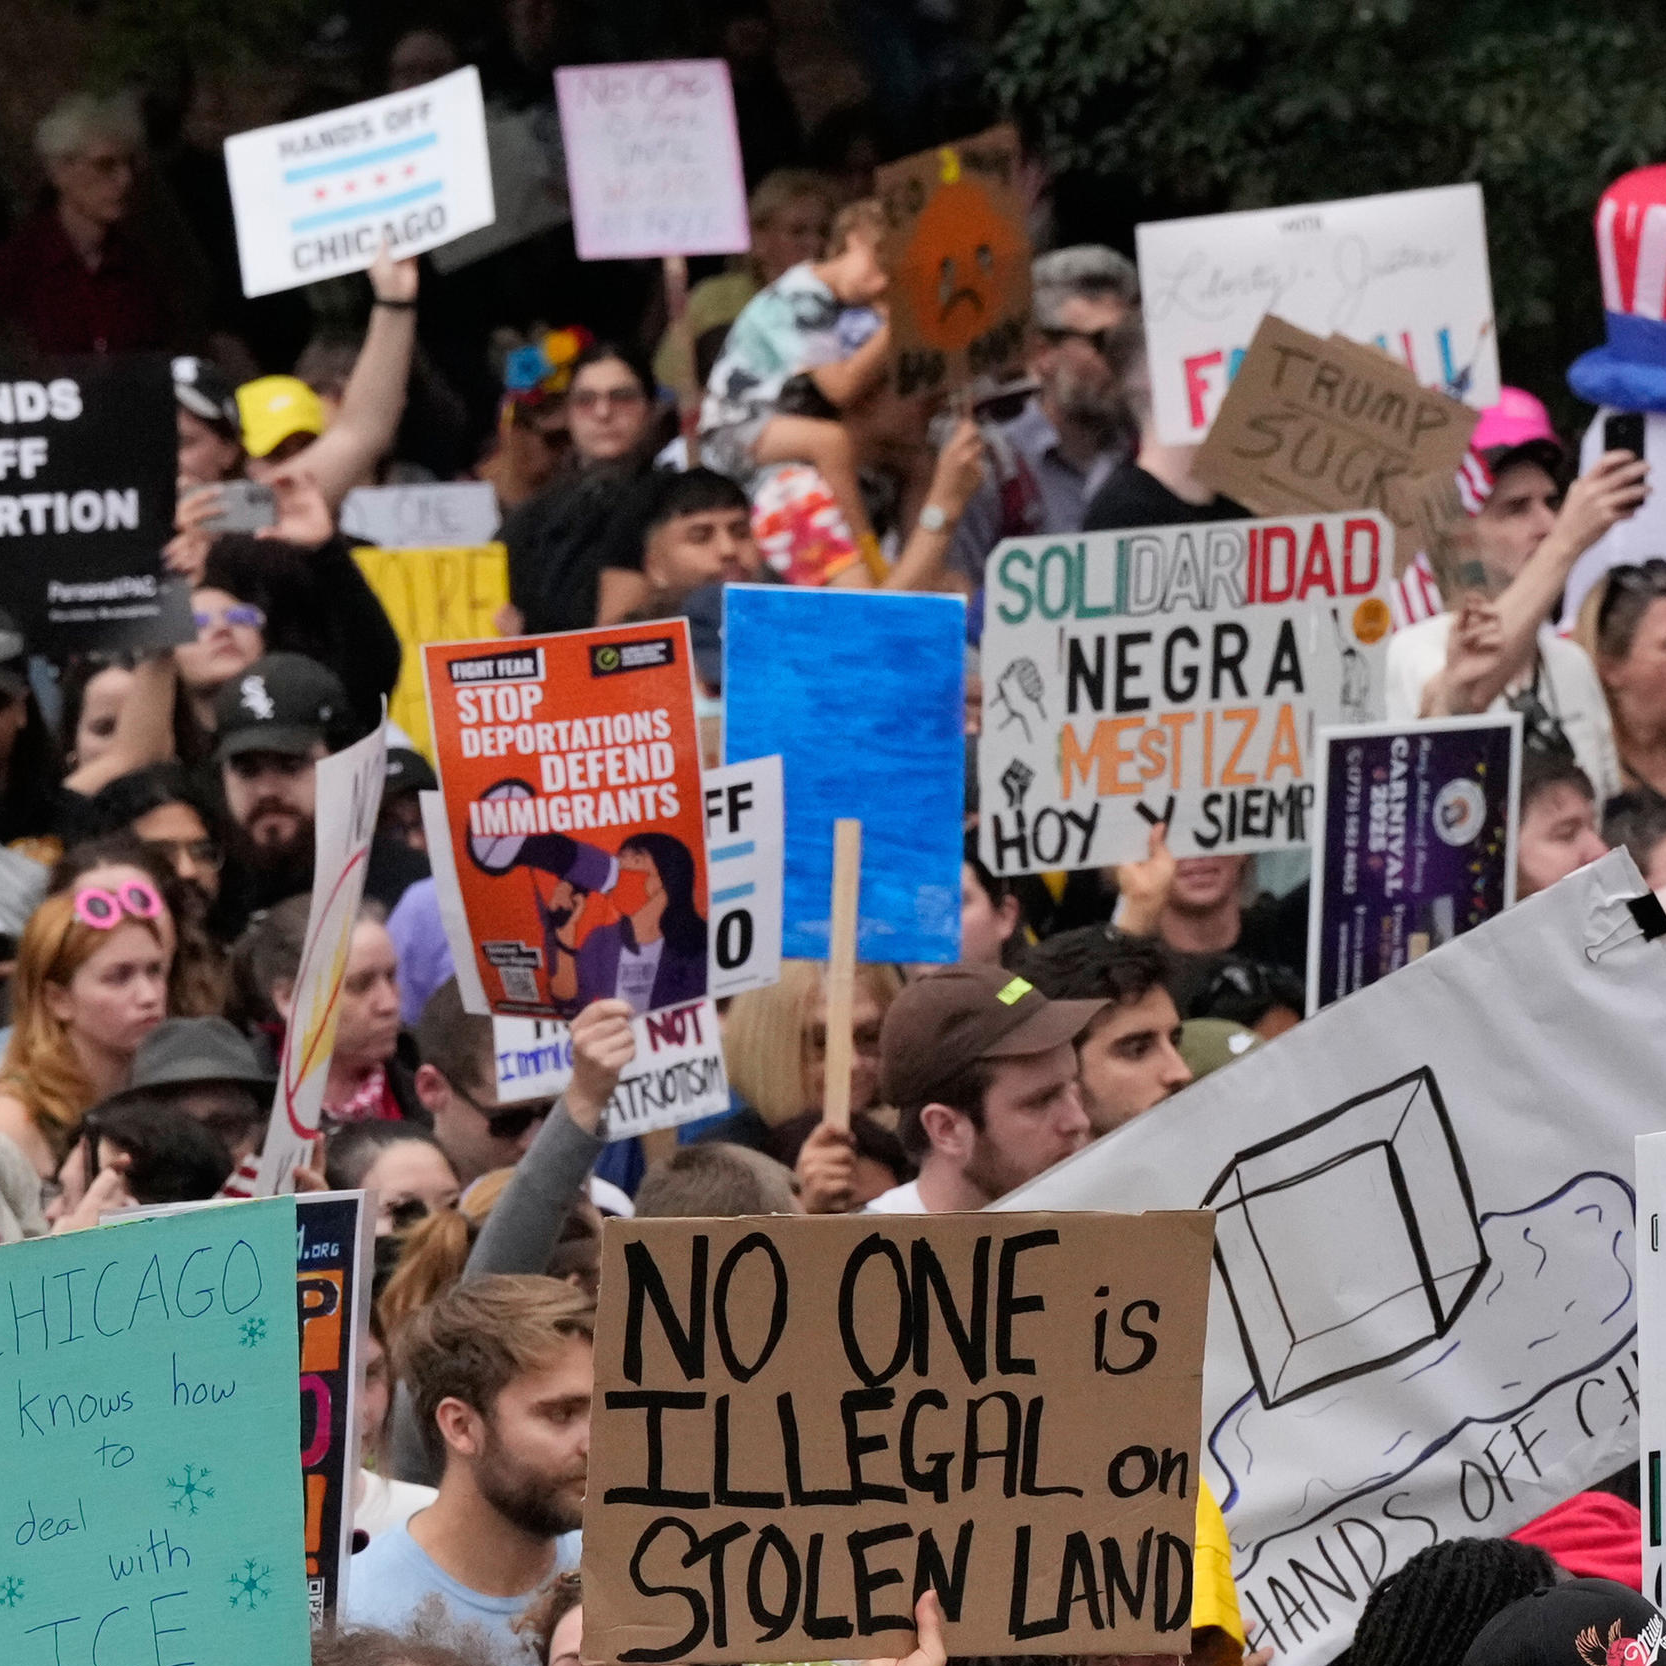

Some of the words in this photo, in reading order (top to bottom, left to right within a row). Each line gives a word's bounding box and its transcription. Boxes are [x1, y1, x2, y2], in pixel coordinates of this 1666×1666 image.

[278, 118, 379, 160] HANDS
[382, 101, 435, 138] OFF
[291, 204, 447, 273] CHICAGO
[1271, 345, 1449, 445] TRUMP
[996, 519, 1380, 624] SOLIDARIDAD
[1068, 619, 1303, 712] NEGRA
[456, 684, 543, 726] STOP
[460, 708, 671, 760] DEPORTATIONS
[540, 742, 675, 794] DEFEND
[469, 783, 680, 838] IMMIGRANTS
[994, 802, 1101, 873] HOY
[646, 1001, 706, 1055] NOT
[606, 1056, 723, 1137] ATRIOTISM
[624, 1231, 787, 1385] NO
[838, 1228, 1059, 1387] ONE
[1093, 1284, 1159, 1376] is
[16, 1376, 135, 1440] knows
[172, 1352, 237, 1407] how
[94, 1434, 135, 1471] to
[603, 1387, 1084, 1509] ILLEGAL
[1108, 1444, 1189, 1500] on
[15, 1497, 87, 1547] deal
[108, 1529, 192, 1583] with
[617, 1515, 975, 1664] STOLEN
[1007, 1520, 1195, 1642] LAND
